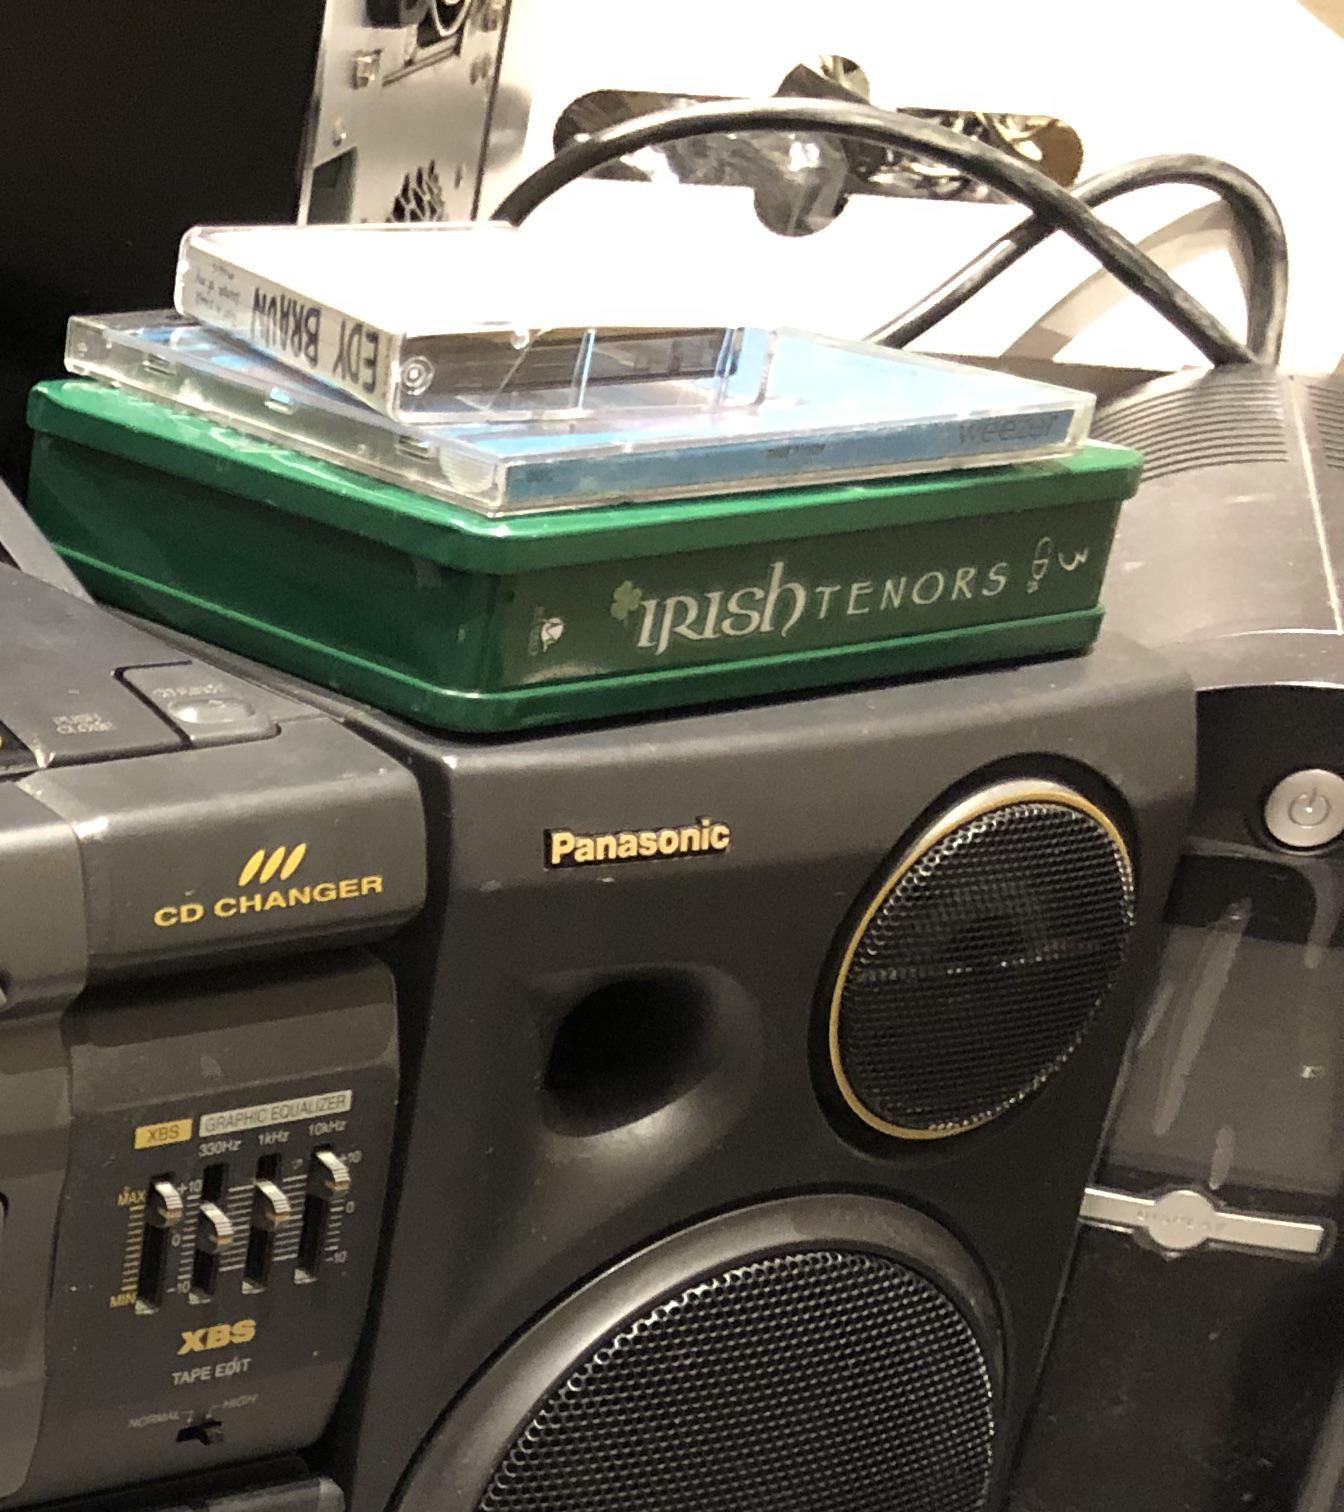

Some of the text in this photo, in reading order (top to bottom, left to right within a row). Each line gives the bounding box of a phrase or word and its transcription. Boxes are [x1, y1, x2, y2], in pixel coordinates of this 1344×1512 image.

[251, 287, 322, 367] BRAUN
[332, 319, 380, 394] EDY
[815, 561, 1008, 620] TENORS
[551, 817, 731, 865] Panasonic
[153, 875, 384, 927] CD CHANGER
[206, 1095, 346, 1132] GRAPHIC EQUALIZER
[308, 1120, 347, 1136] 10kHz
[147, 1125, 180, 1145] XBS
[258, 1131, 290, 1145] 1kHz
[177, 1319, 256, 1355] XBS
[172, 1358, 252, 1385] TAPE EDIT
